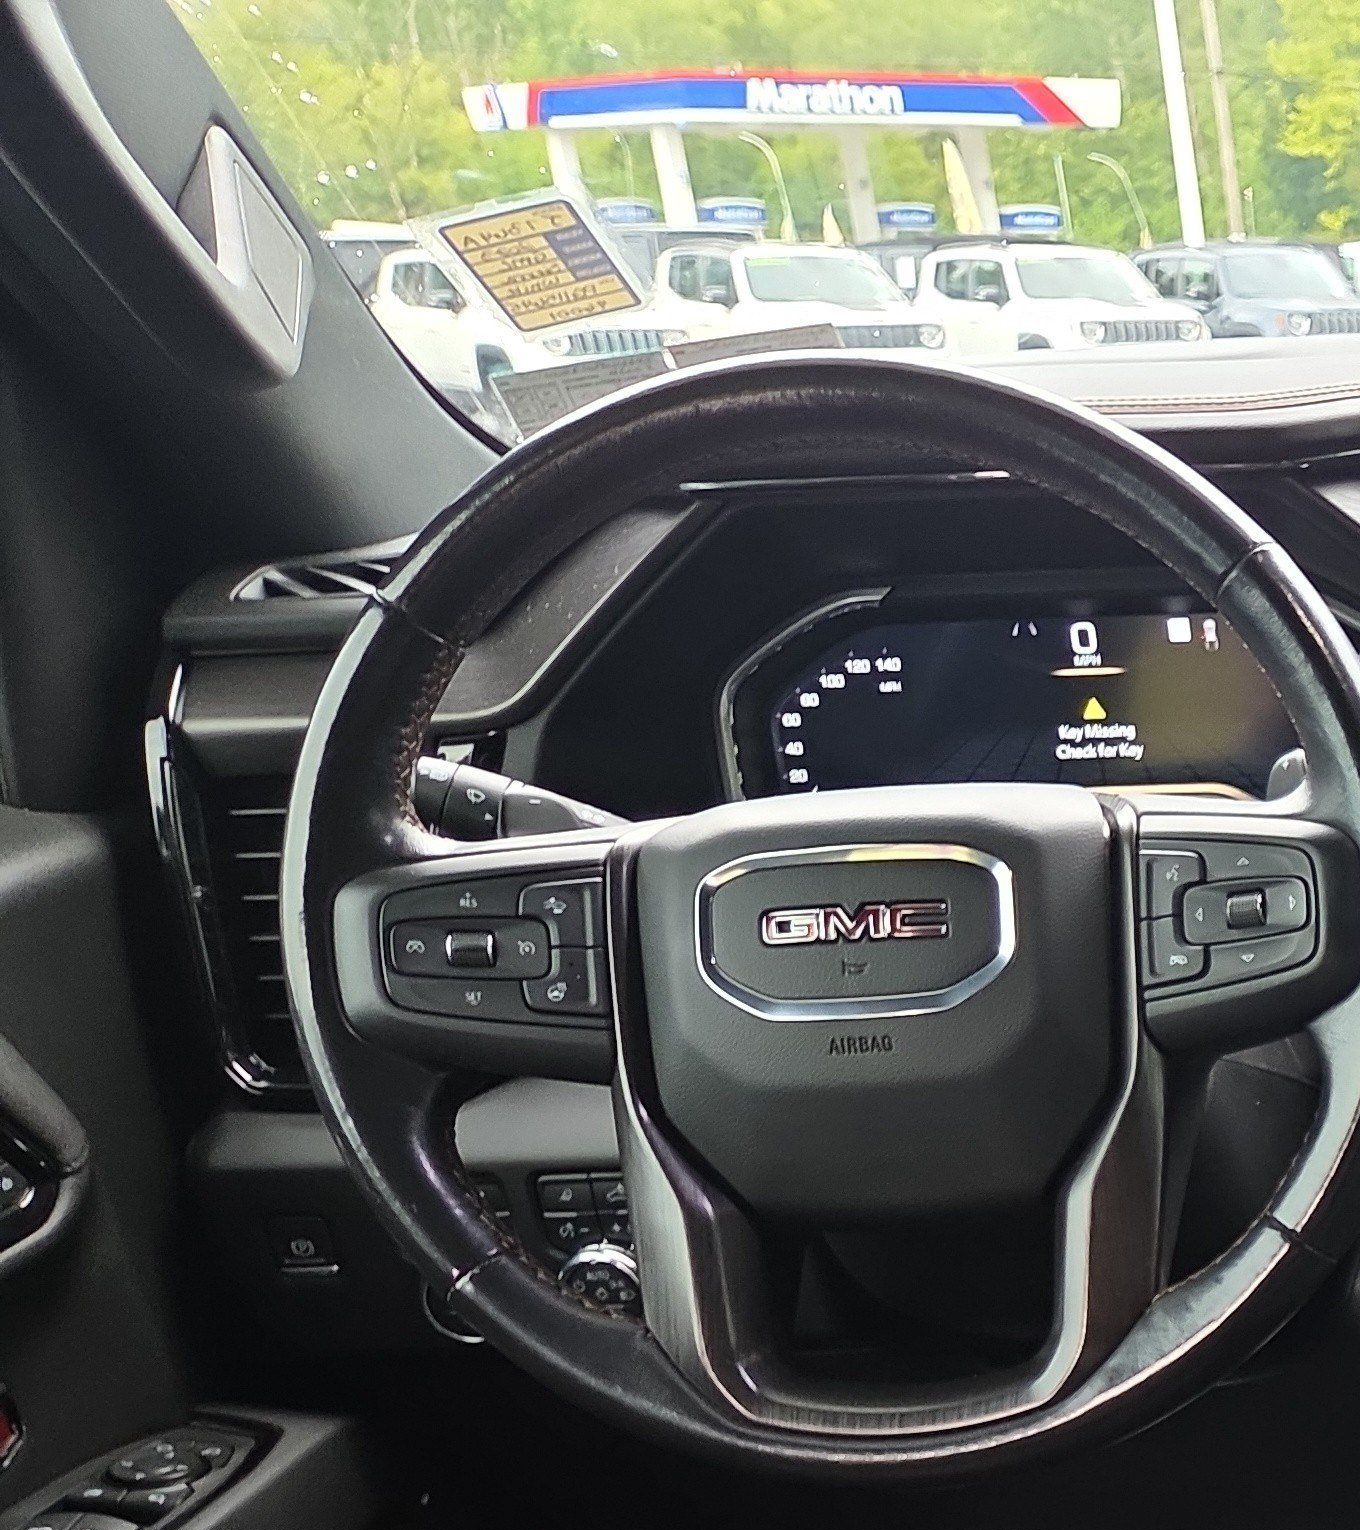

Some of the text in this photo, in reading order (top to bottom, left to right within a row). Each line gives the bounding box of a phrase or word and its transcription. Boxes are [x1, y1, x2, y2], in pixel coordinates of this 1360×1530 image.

[746, 77, 905, 115] Marathon
[1069, 621, 1098, 655] 0
[844, 658, 871, 674] 120
[875, 656, 902, 673] 140
[818, 673, 846, 689] 100
[1057, 723, 1136, 743] Key Missing
[1055, 743, 1097, 760] Check
[1118, 742, 1145, 761] Key
[788, 768, 809, 784] 20
[759, 900, 949, 945] GMC
[828, 1035, 894, 1056] AIRBAG
